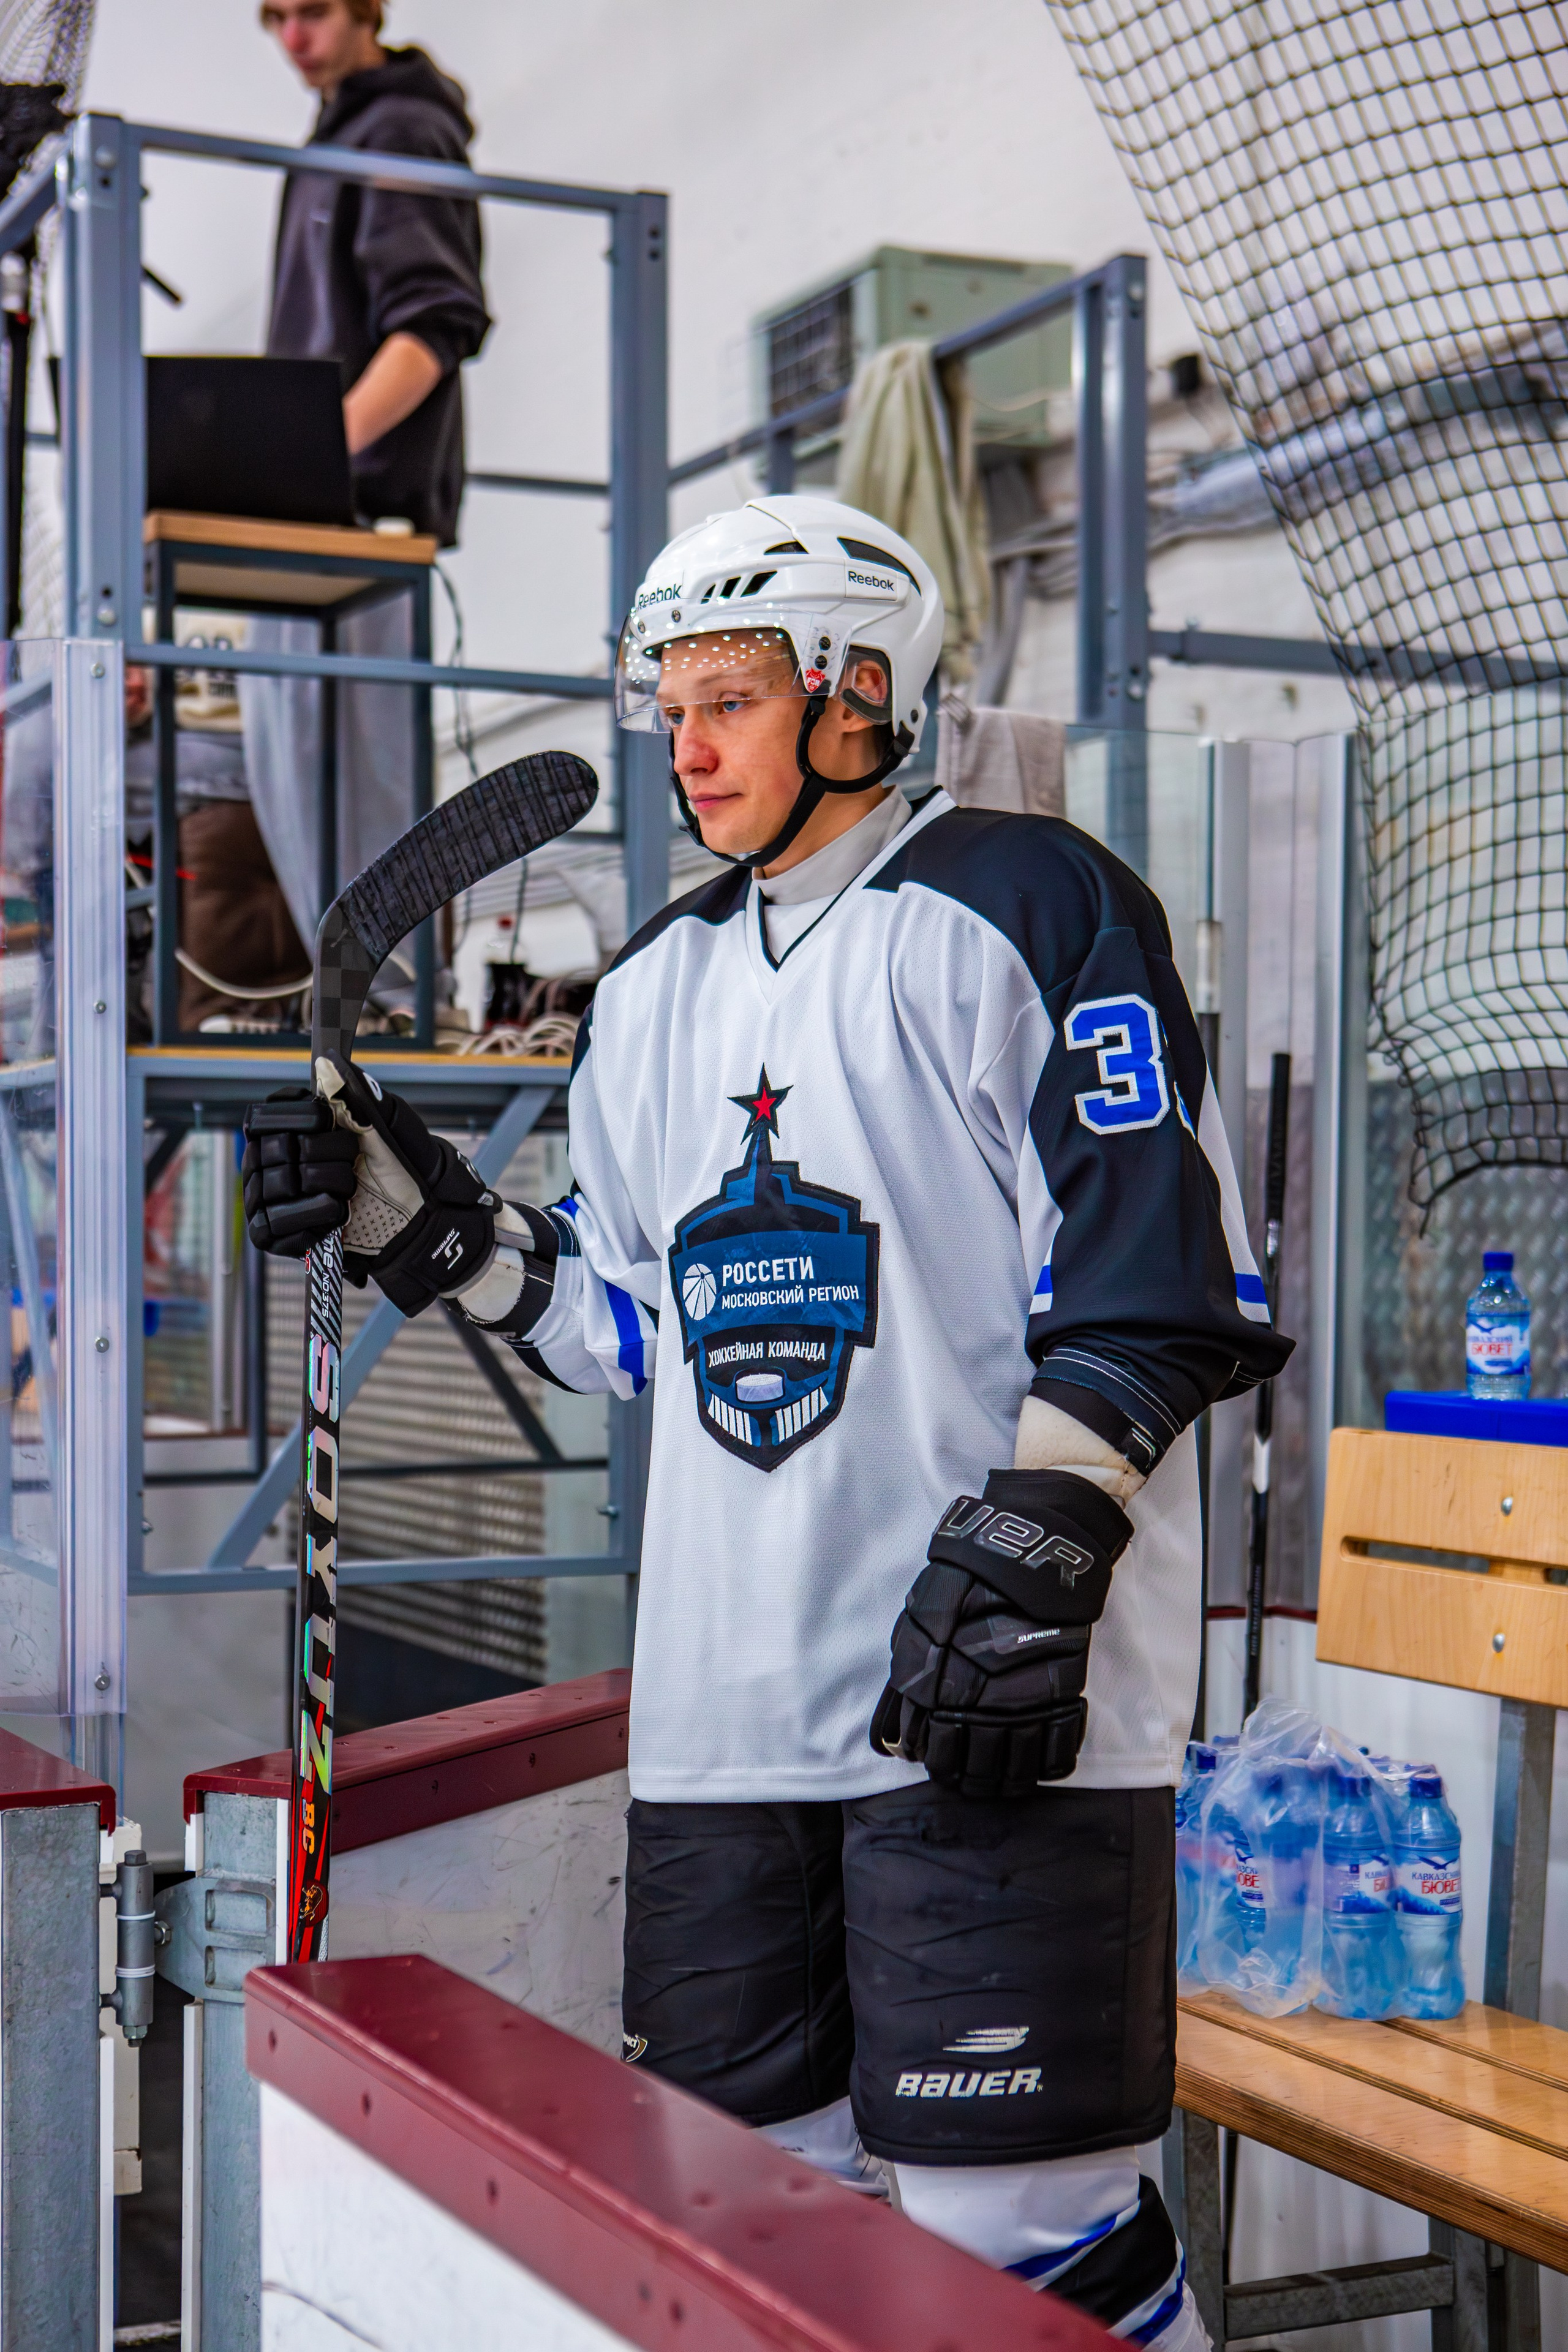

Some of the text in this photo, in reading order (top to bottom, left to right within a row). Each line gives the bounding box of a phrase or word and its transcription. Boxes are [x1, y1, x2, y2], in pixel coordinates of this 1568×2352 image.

[847, 570, 895, 592] Reebok
[638, 583, 682, 611] Reebok
[722, 1256, 815, 1287] РОССЕТИ
[722, 1284, 859, 1310] МОСКОВСКИЙ РЕГИОН
[708, 1341, 826, 1368] ХОККЕЙНАЯ КОМАНДА
